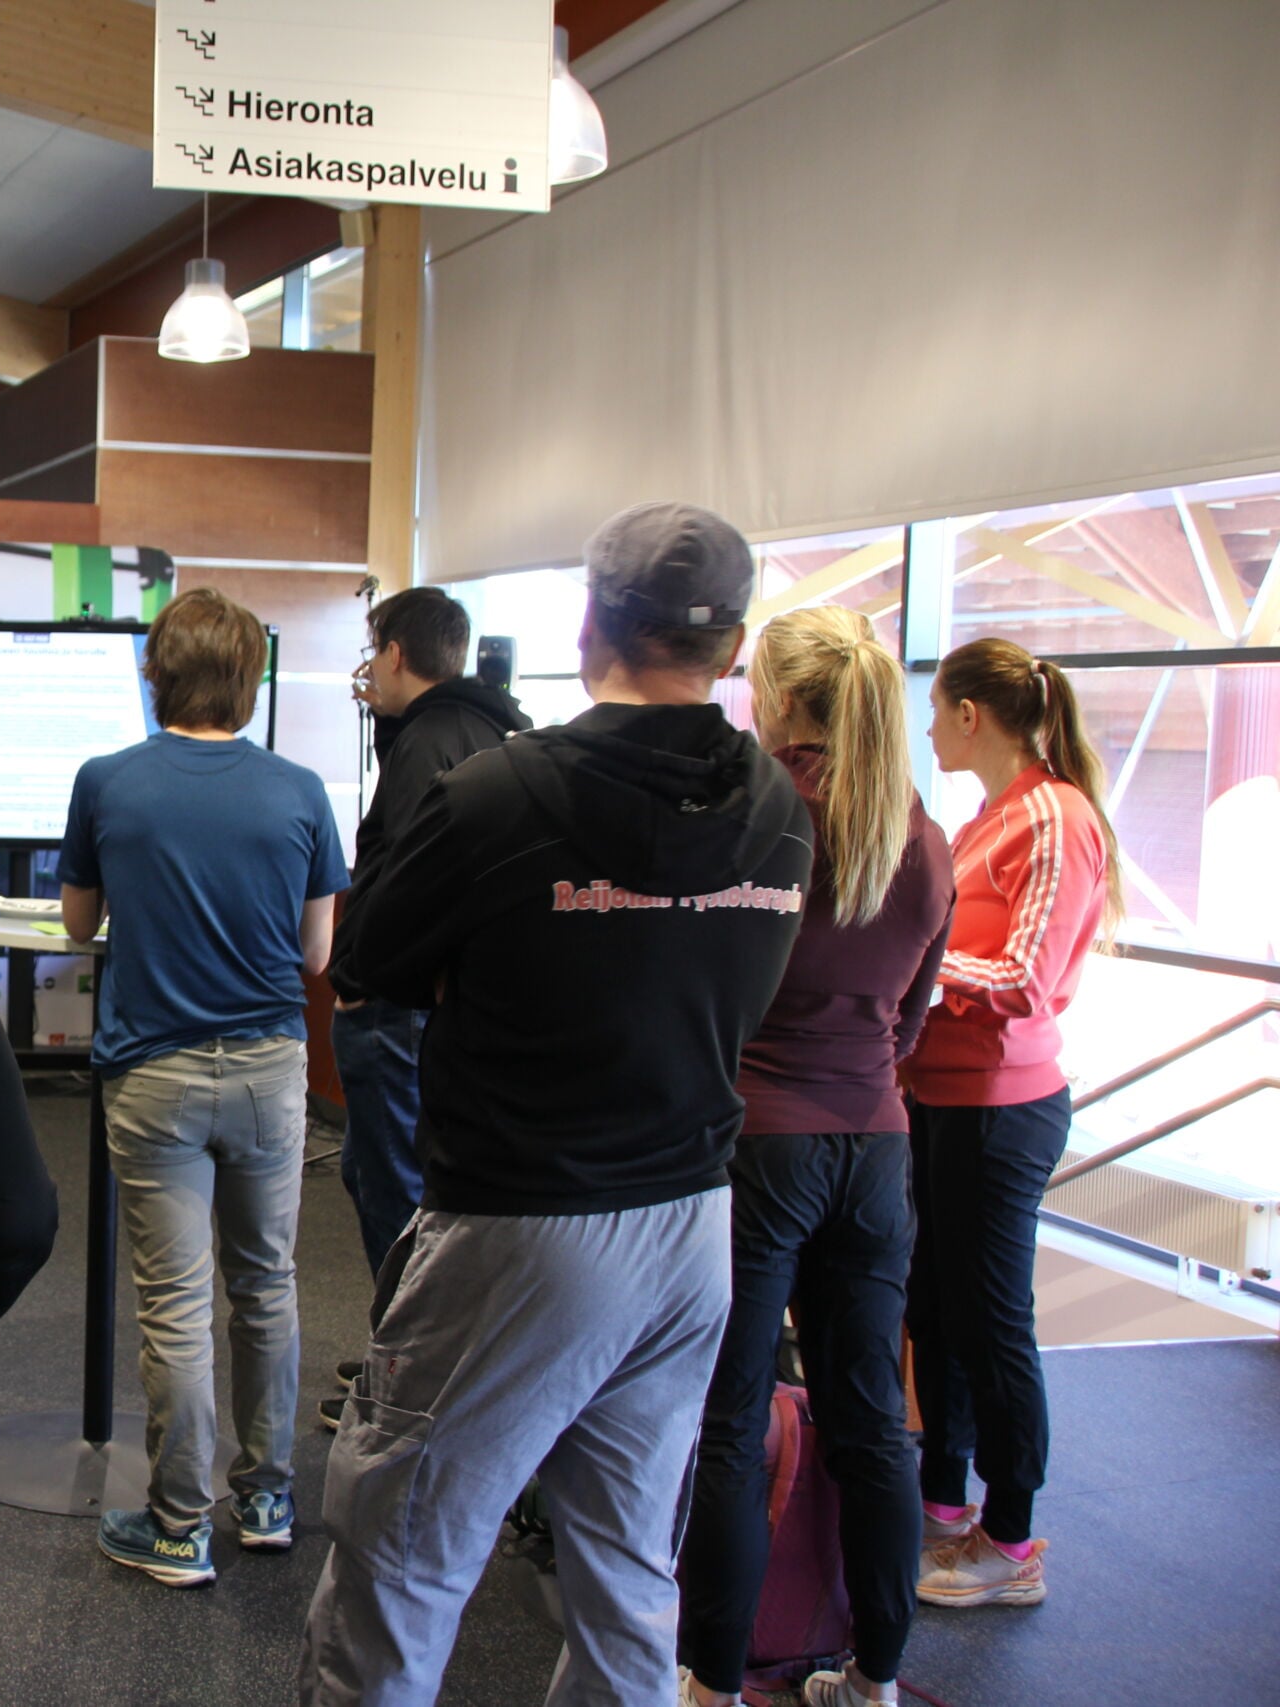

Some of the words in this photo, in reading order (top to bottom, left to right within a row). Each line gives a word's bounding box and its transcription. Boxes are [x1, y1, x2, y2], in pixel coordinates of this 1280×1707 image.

[227, 90, 375, 127] Hieronta
[228, 147, 487, 191] Asiakaspalvelu
[154, 1539, 195, 1559] HOKA
